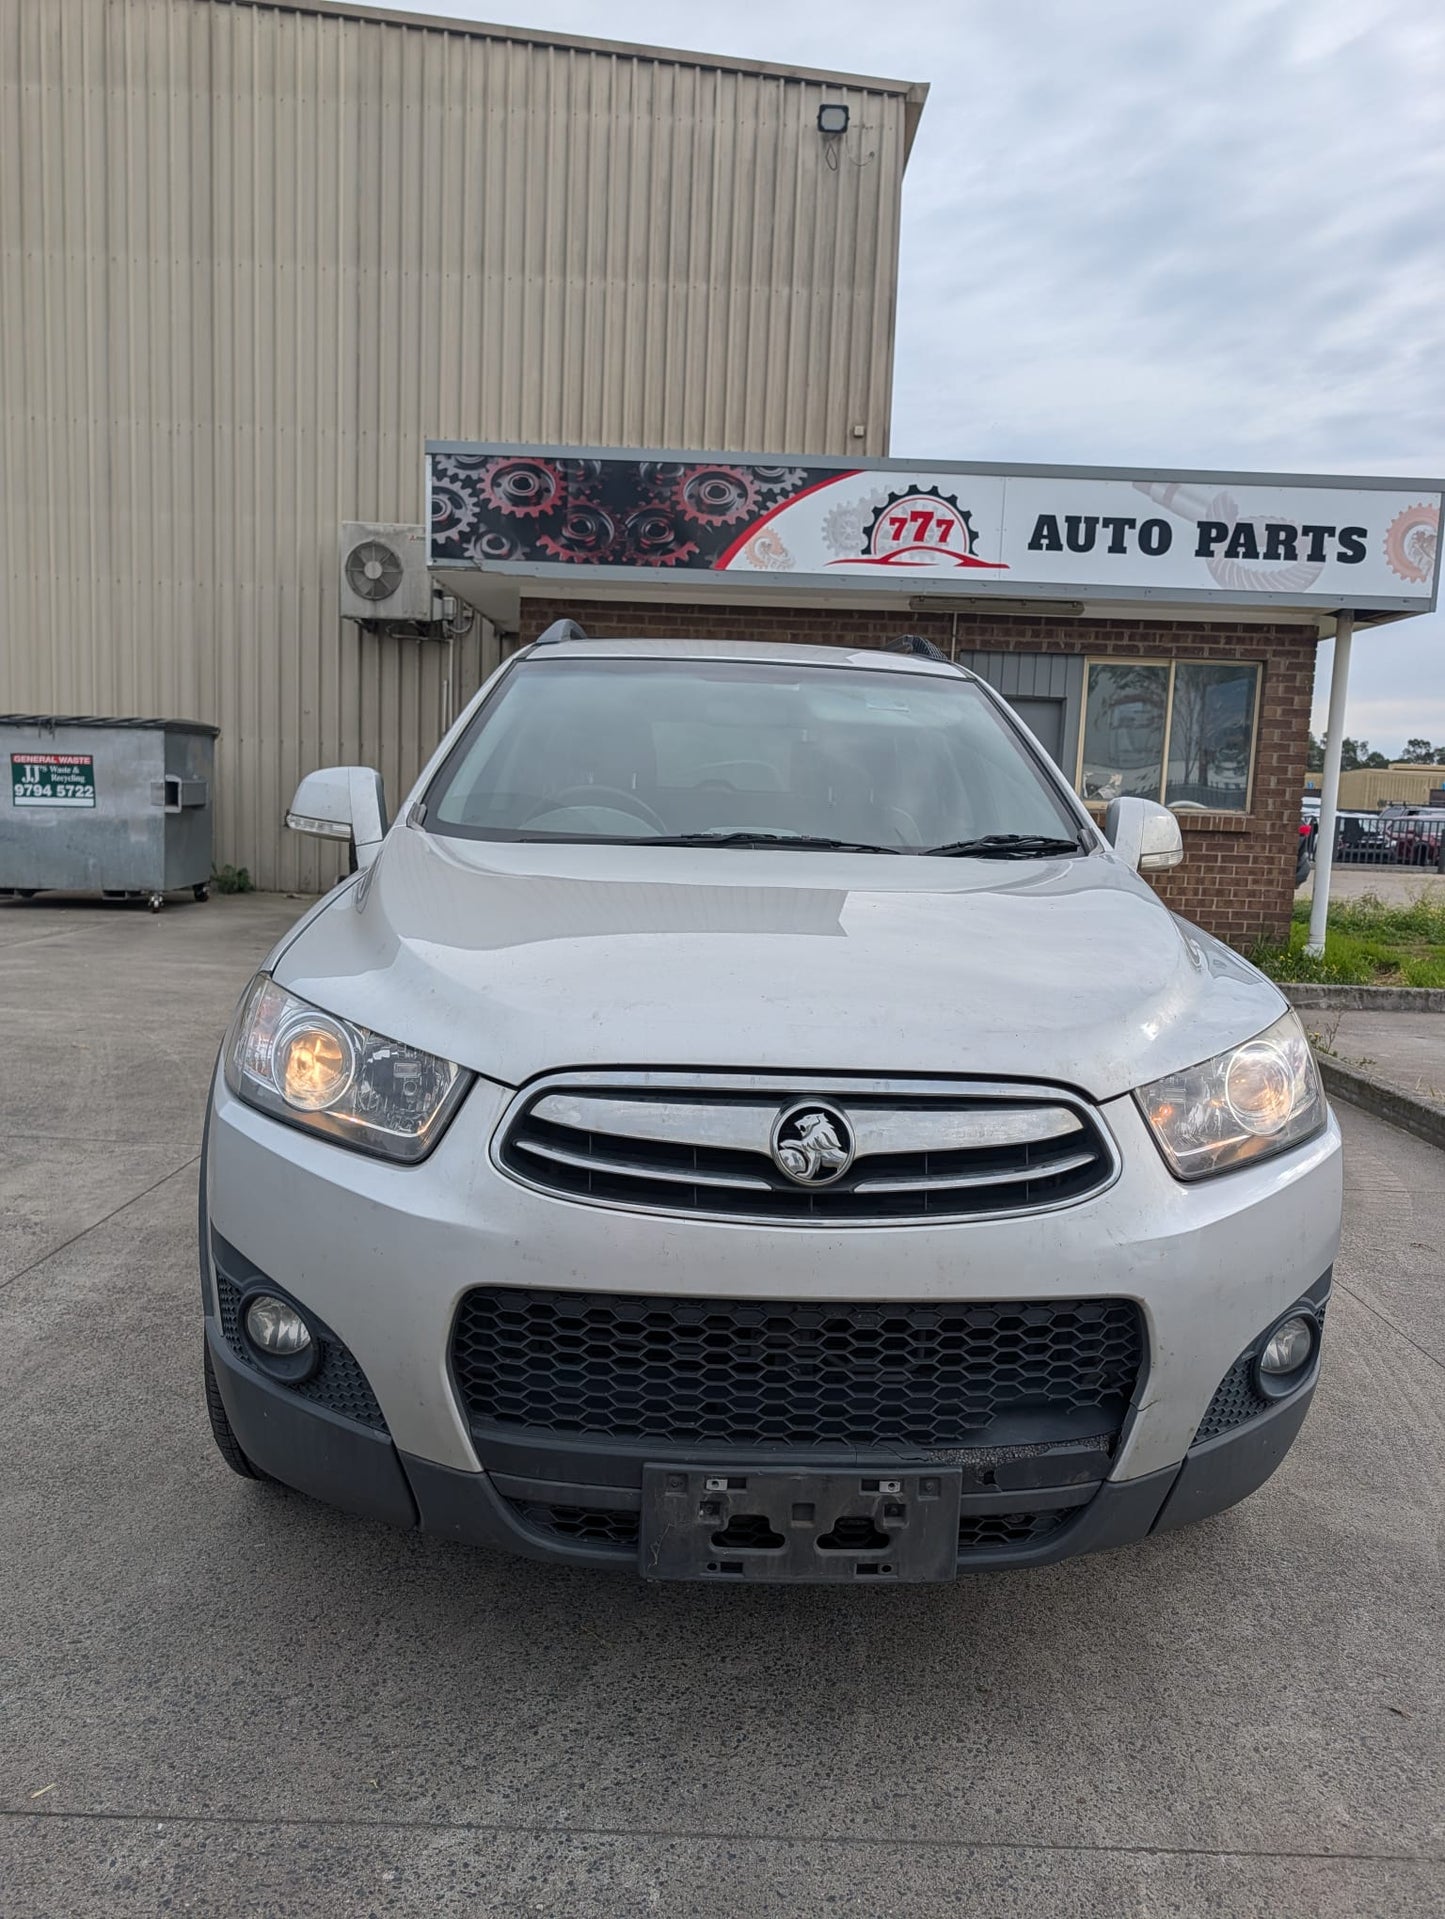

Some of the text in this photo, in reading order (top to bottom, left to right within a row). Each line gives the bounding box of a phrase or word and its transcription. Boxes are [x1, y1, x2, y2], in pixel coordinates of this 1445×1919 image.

[889, 510, 1368, 565] 777 AUTO PARTS
[13, 755, 91, 765] GENERAL WASTE
[50, 765, 71, 774] Waste
[72, 766, 79, 774] &
[51, 774, 85, 783] Recycling
[14, 784, 94, 798] 9794 5722
